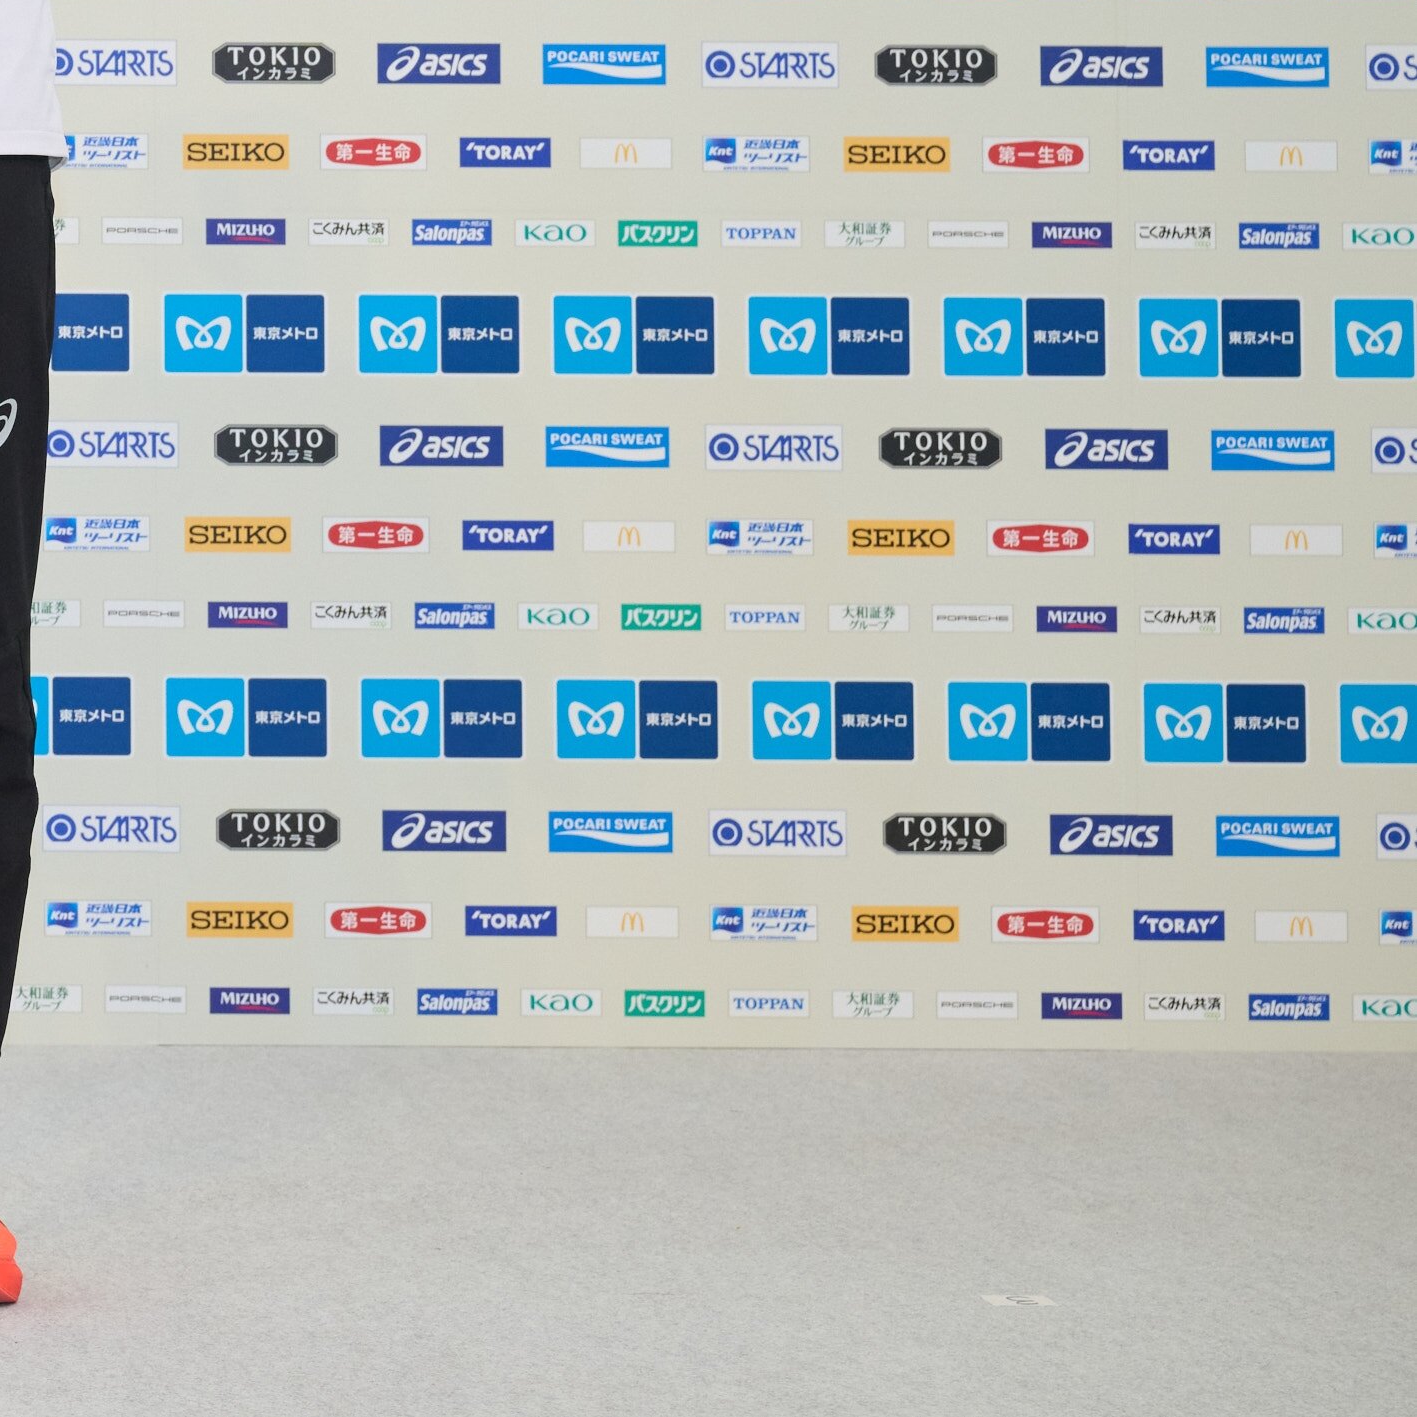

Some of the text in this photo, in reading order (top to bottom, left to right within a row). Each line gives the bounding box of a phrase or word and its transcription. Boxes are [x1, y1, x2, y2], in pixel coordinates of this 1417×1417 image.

[420, 53, 487, 76] asics
[848, 146, 946, 164] SEIKO
[998, 146, 1074, 164] 第一生命
[621, 224, 695, 243] バスクリン
[726, 227, 795, 240] TOPPAN
[898, 817, 993, 837] TOKIO
[1092, 824, 1161, 848] asics
[1220, 822, 1334, 834] POCARI SWEAT
[908, 838, 983, 851] インカラミ
[340, 912, 416, 930] 第一生命
[856, 914, 954, 934] SEIKO
[220, 992, 279, 1004] MIZUHO
[420, 994, 490, 1012] Salonpas
[733, 998, 804, 1010] TOPPAN
